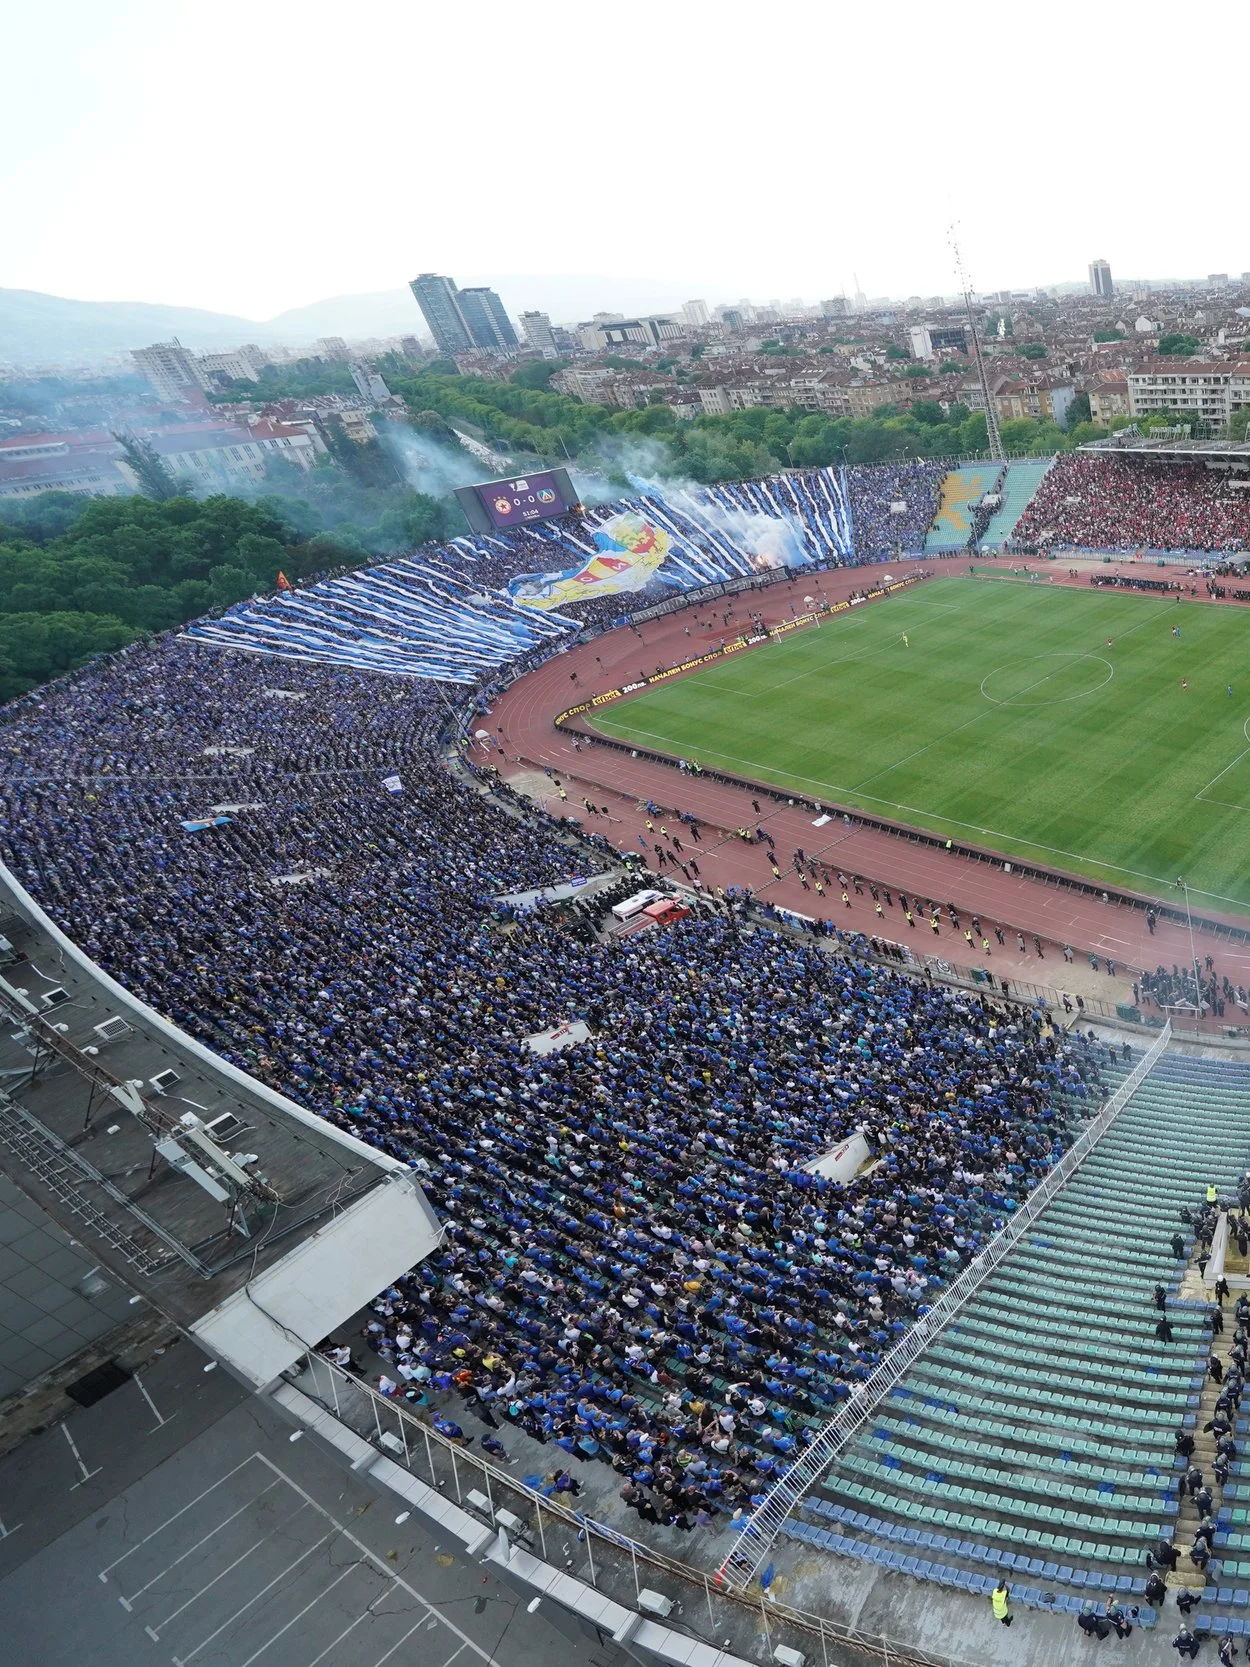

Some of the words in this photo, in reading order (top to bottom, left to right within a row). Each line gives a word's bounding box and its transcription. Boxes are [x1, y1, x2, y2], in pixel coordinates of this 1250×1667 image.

[513, 498, 521, 506] 0
[527, 495, 535, 503] 0
[649, 667, 681, 683] НАЧАЛЕН
[681, 658, 703, 670] БОНУС
[594, 691, 619, 705] efbet
